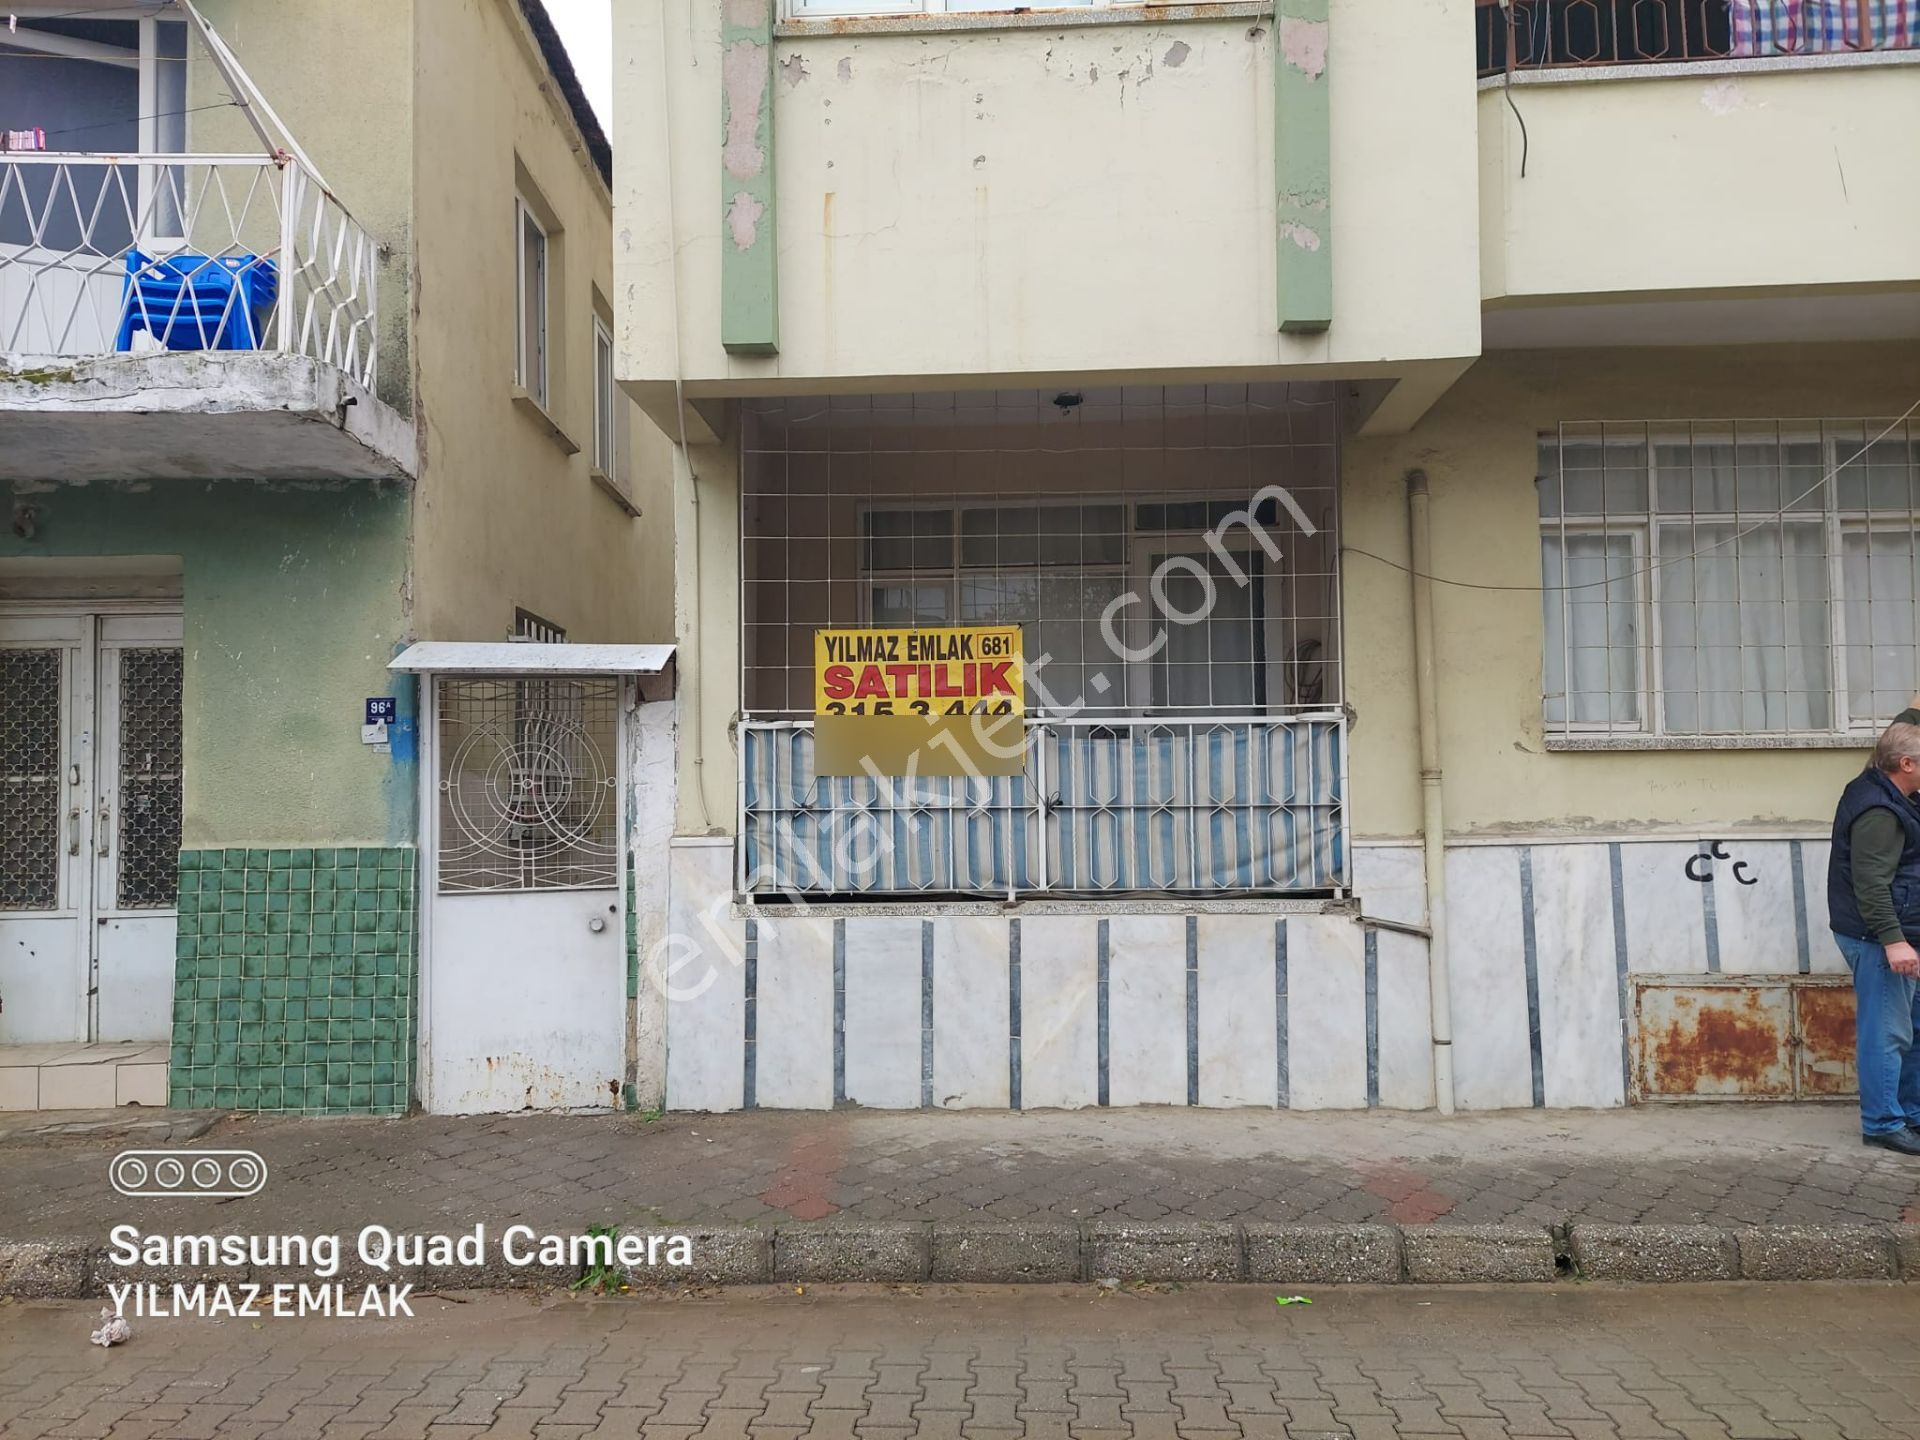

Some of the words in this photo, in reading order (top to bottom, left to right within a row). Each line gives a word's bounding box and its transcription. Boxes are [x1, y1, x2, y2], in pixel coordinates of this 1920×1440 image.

[824, 636, 899, 662] YILMAZ
[907, 634, 973, 661] EMLAK
[982, 637, 1010, 655] 681
[824, 662, 1015, 699] SATILIK
